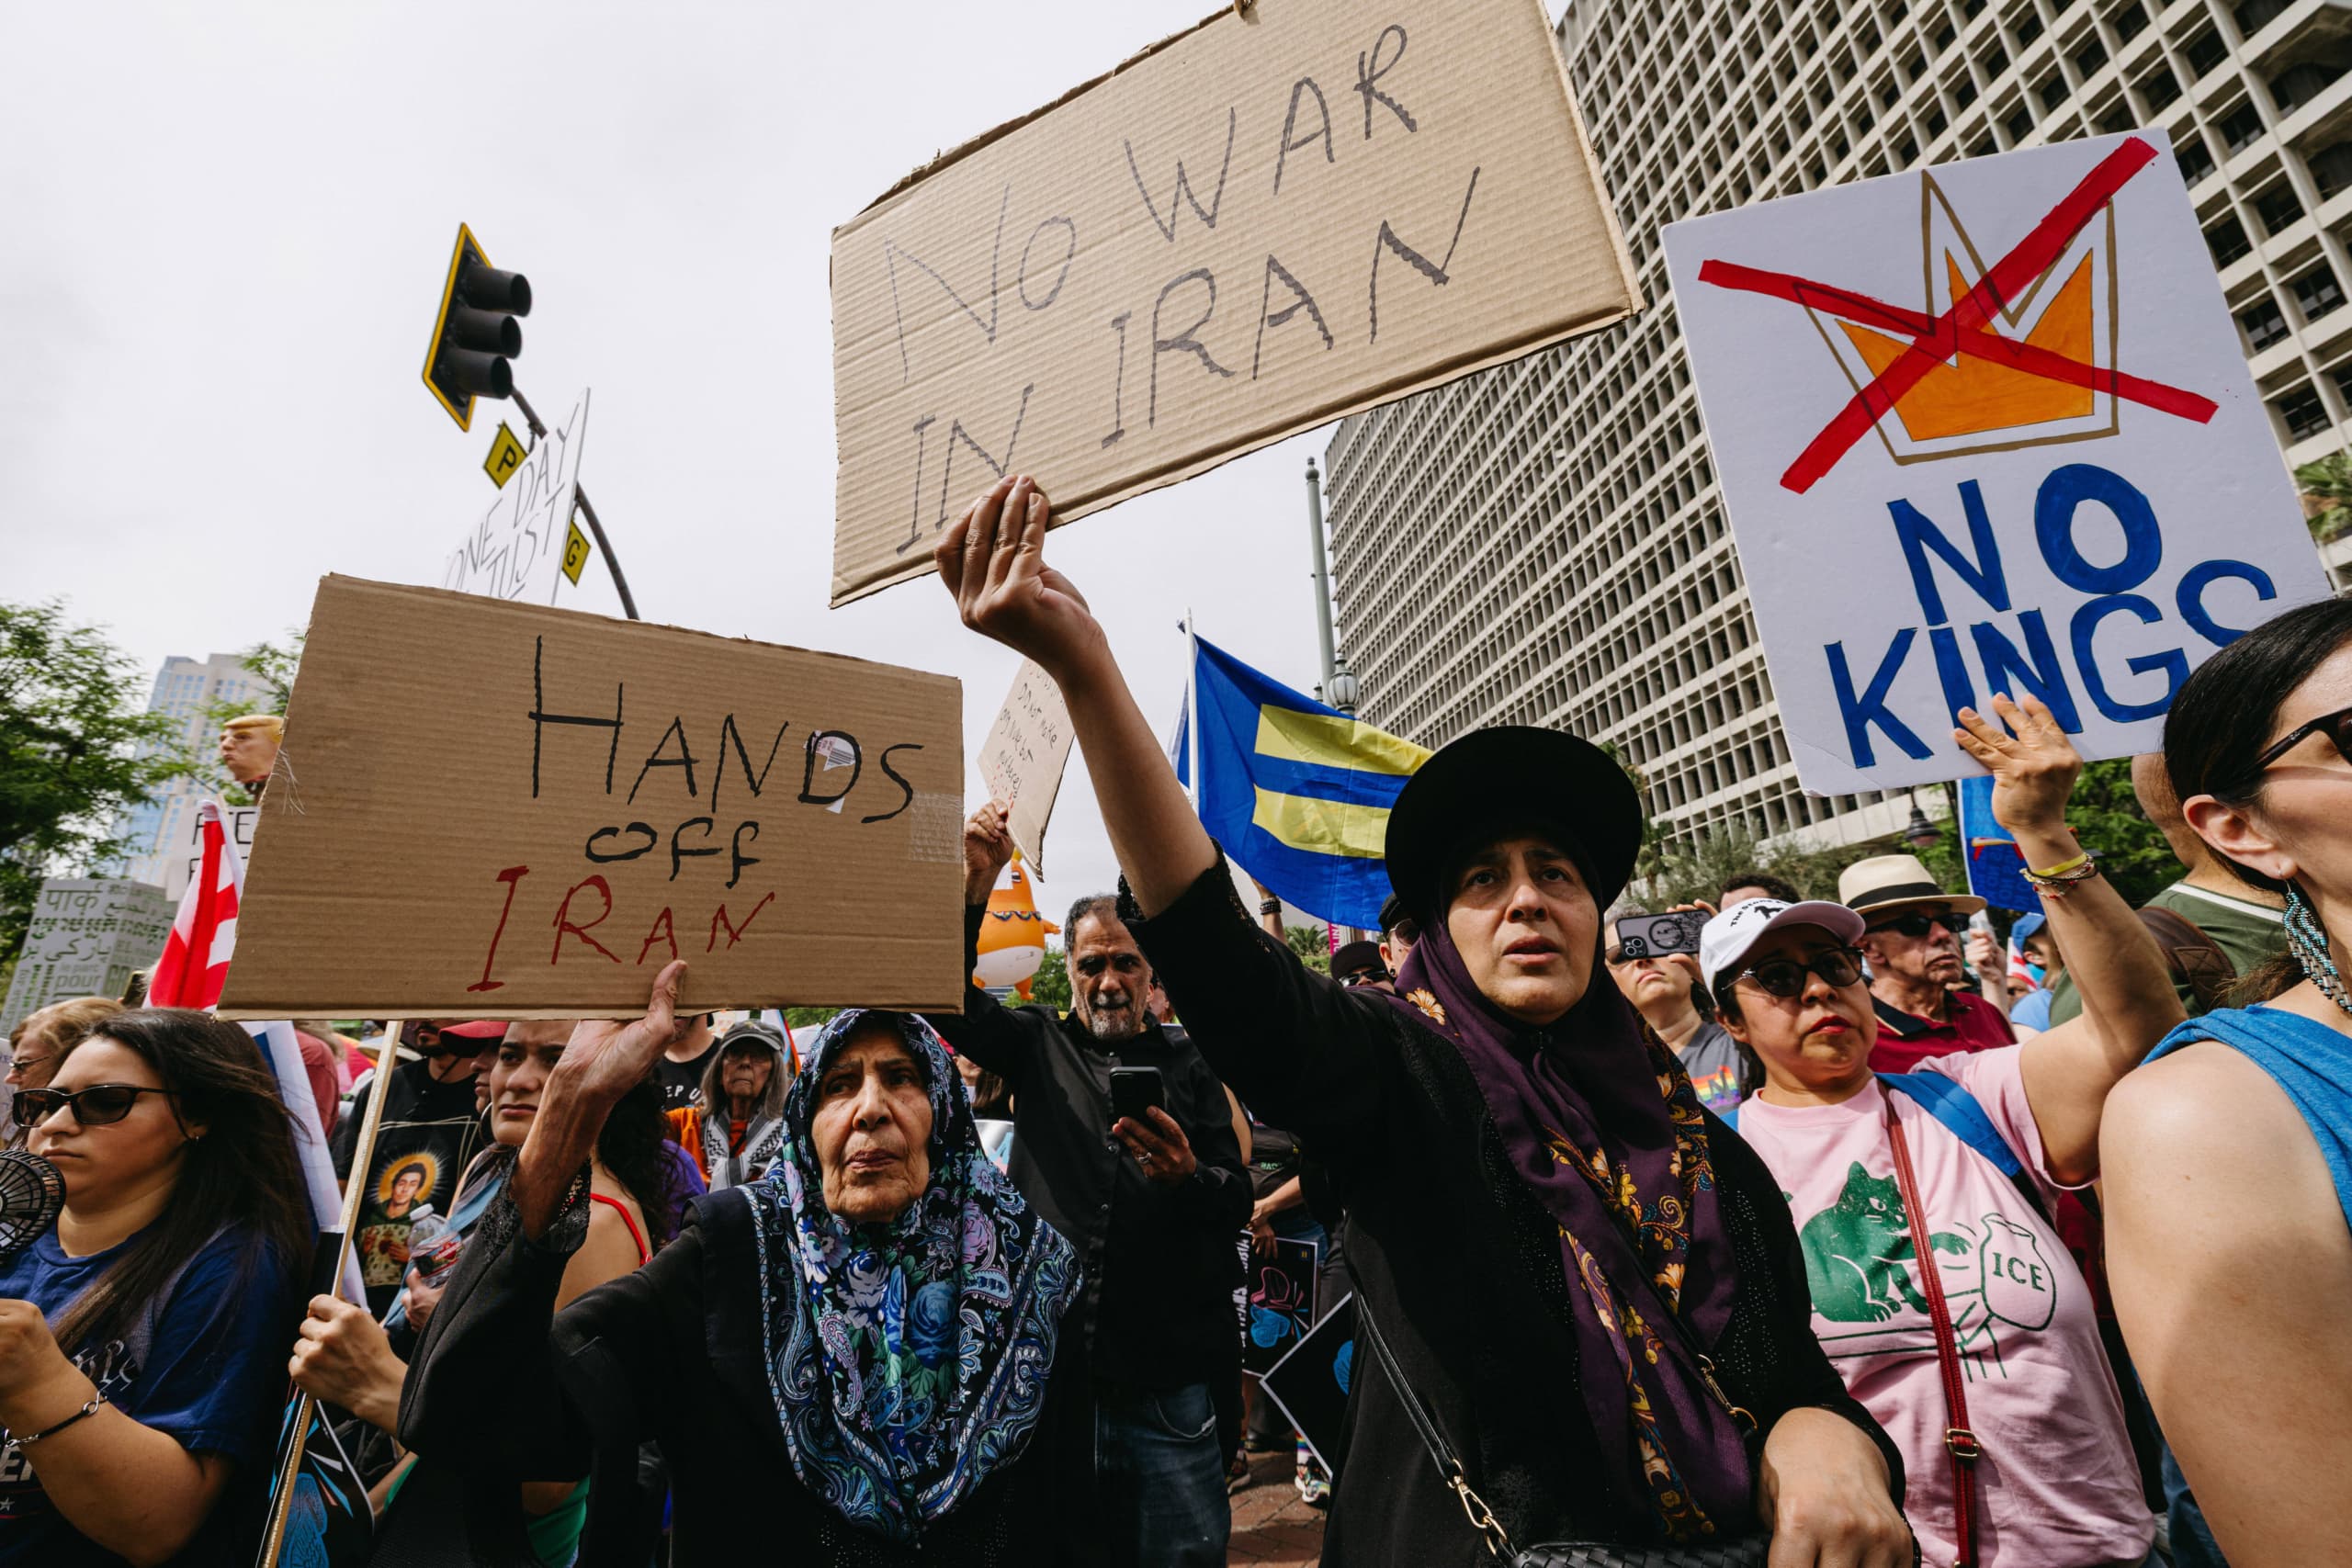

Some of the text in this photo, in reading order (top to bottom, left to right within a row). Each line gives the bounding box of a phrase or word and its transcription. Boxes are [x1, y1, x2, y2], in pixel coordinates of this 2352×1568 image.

[884, 25, 1418, 383] NO WAR
[897, 166, 1480, 554] IN IRAN
[514, 402, 580, 528] DAY
[1886, 463, 2163, 626] NO
[528, 636, 923, 823] HANDS
[54, 975, 102, 991] pour
[467, 865, 775, 991] IRAN
[1992, 1252, 2047, 1292] ICE
